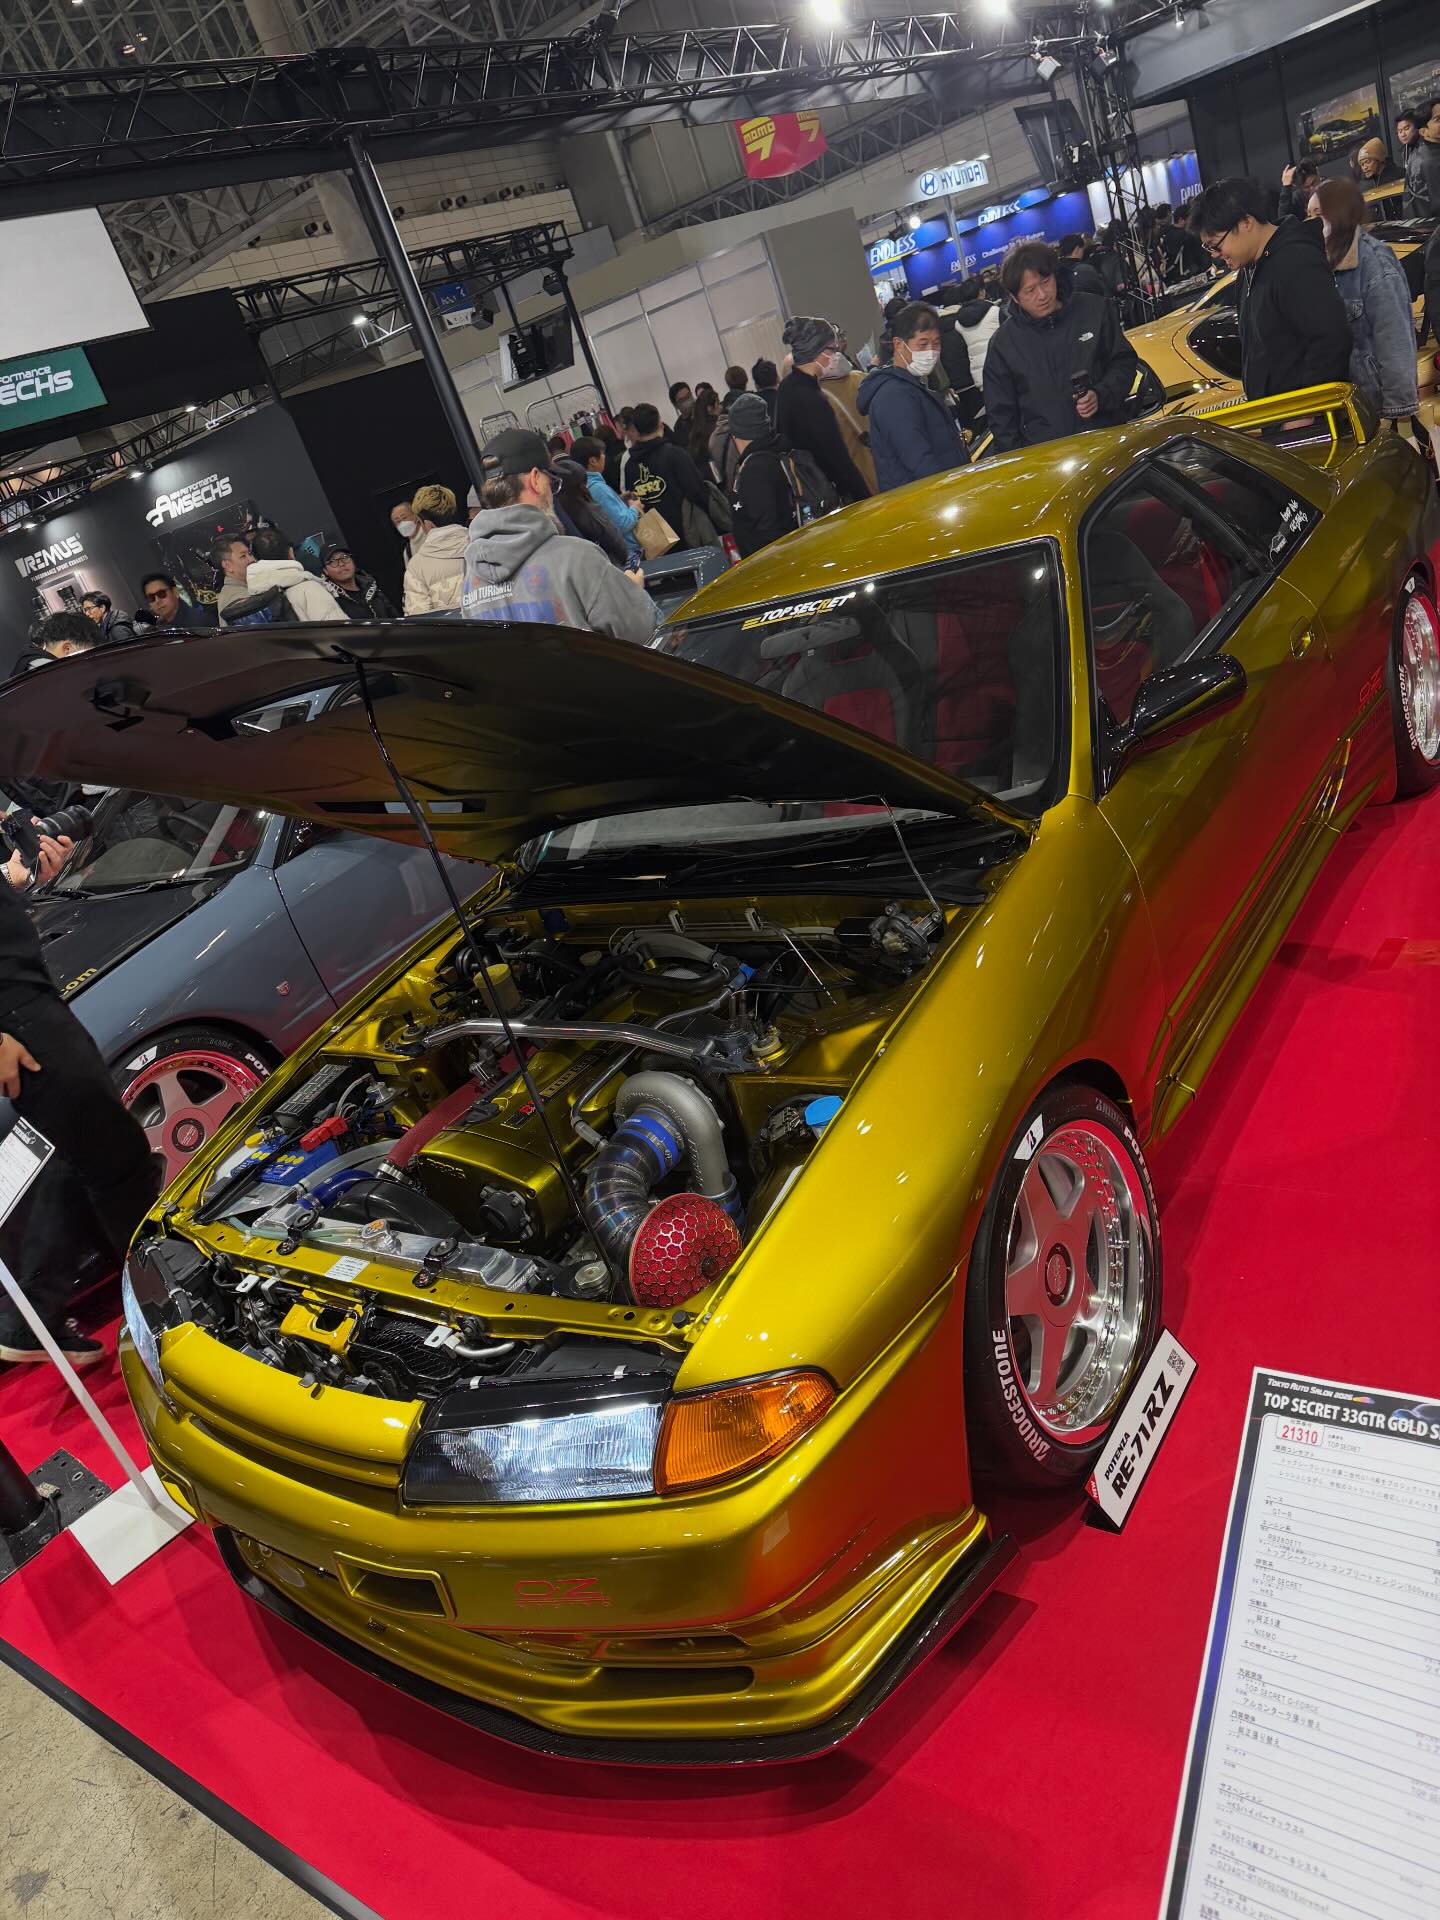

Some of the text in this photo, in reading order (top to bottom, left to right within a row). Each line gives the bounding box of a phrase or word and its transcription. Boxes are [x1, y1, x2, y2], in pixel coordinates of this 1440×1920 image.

[940, 163, 985, 190] HYUNDAI
[977, 200, 1022, 227] ENDLESS
[870, 232, 916, 266] ENDLESS
[146, 477, 233, 527] AMSECHS
[22, 535, 84, 575] REMUS
[992, 1329, 1051, 1462] BRIDGESTONE
[1267, 1378, 1290, 1389] TOKYO
[1290, 1382, 1310, 1393] AUTO
[1310, 1386, 1334, 1398] SALON
[1264, 1392, 1290, 1410] TOP
[1291, 1397, 1341, 1420] SECRET
[1341, 1407, 1386, 1430] 33GTR
[1387, 1416, 1428, 1437] GOLD
[1111, 1370, 1175, 1499] RE-71RZ
[1281, 1424, 1319, 1445] 21310
[1104, 1431, 1131, 1481] POTENZA
[1091, 1480, 1100, 1499] NEW
